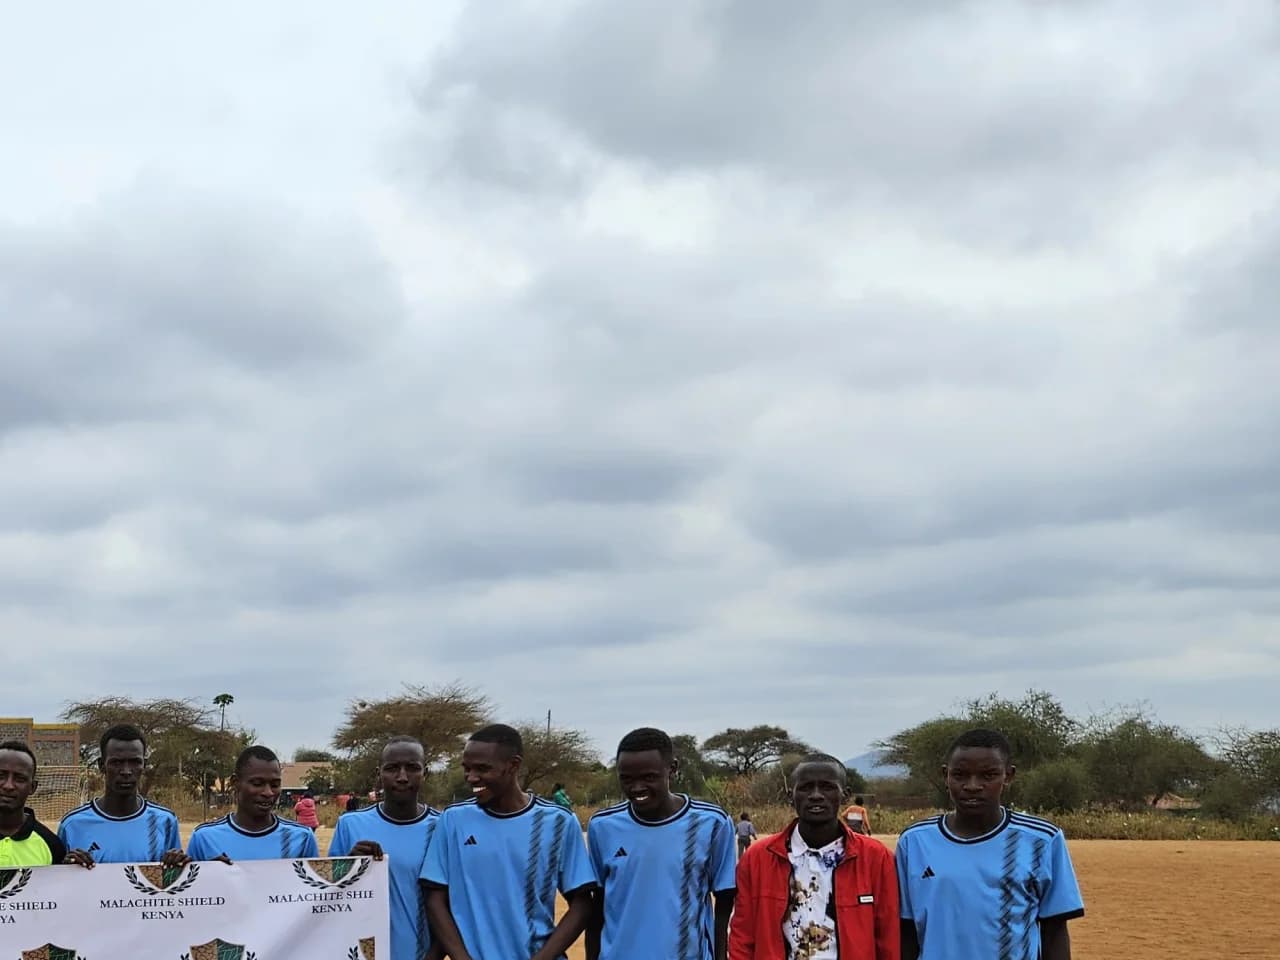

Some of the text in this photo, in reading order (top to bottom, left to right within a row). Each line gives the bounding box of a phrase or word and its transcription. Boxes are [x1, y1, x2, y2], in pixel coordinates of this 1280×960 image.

[268, 891, 343, 903] MALACHITE
[9, 901, 57, 911] SHIELD
[100, 897, 225, 908] MALACHITE SHIELD
[312, 904, 352, 913] KENYA
[141, 911, 184, 920] KENYA
